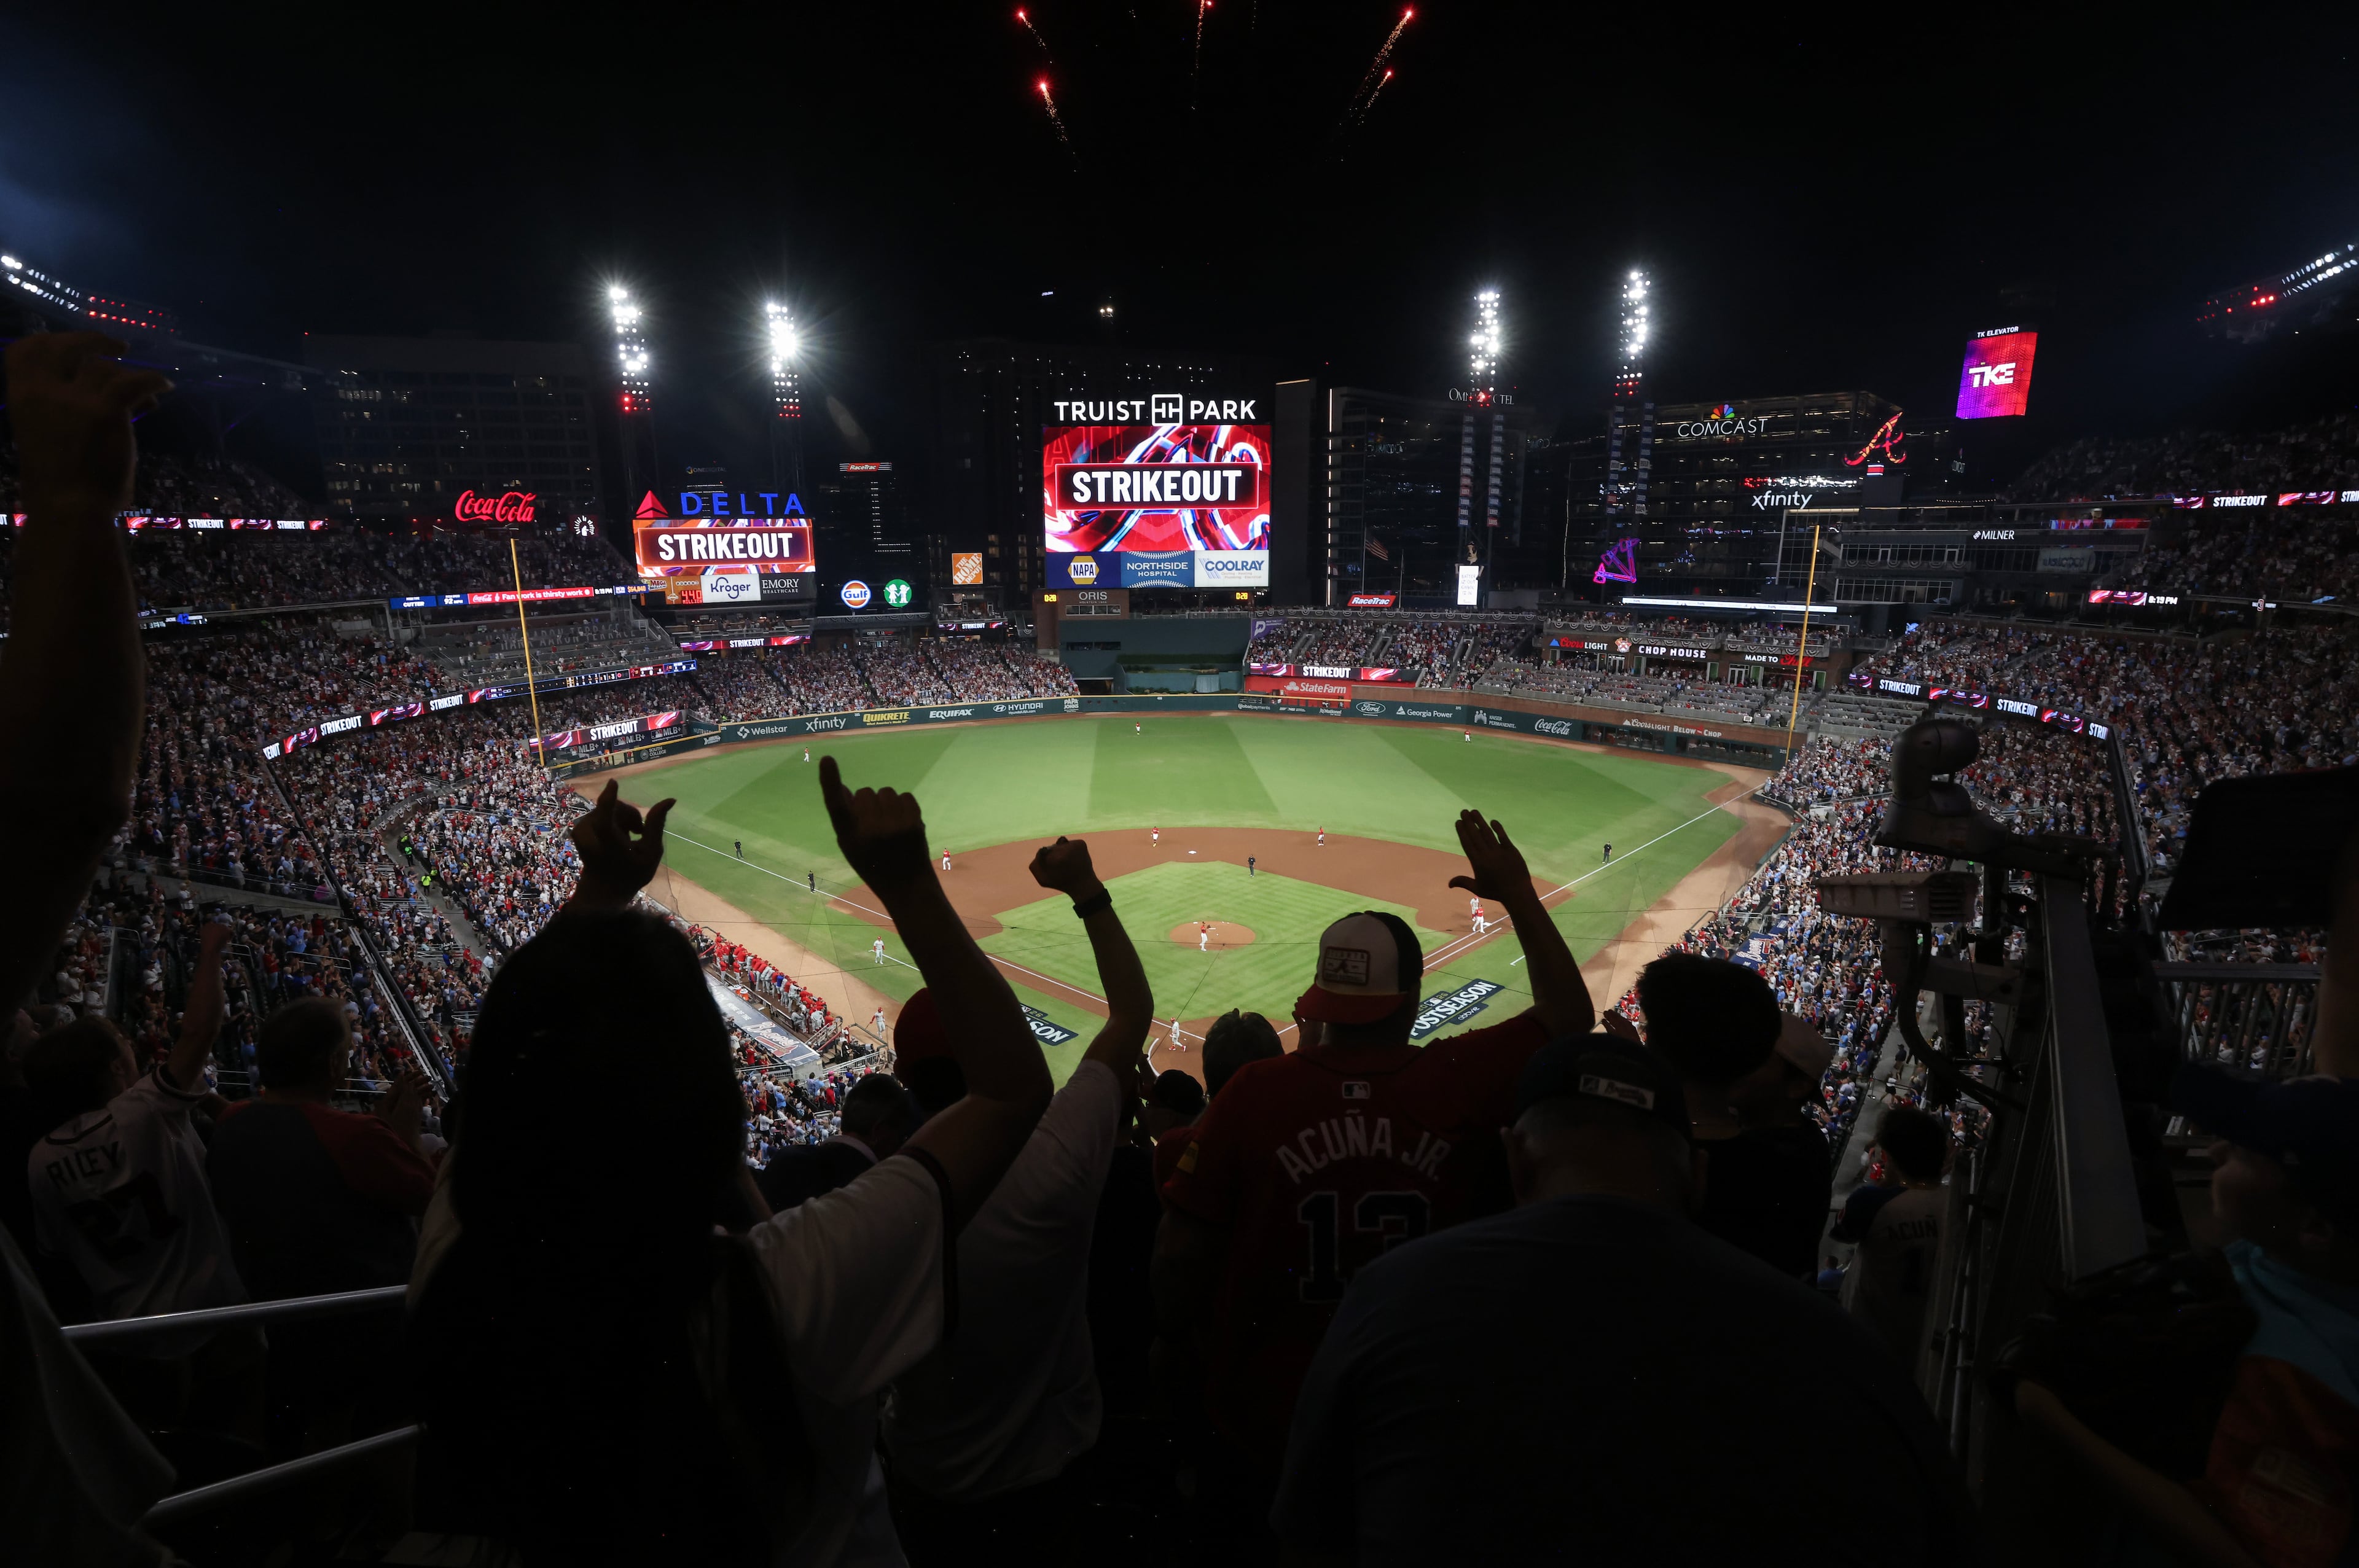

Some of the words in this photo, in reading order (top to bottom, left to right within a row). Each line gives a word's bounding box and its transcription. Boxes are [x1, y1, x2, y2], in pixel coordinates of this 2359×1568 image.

[1987, 326, 2019, 337] ELEVATOR
[1969, 362, 2016, 388] TKE
[1449, 388, 1473, 402] OMN
[1054, 400, 1146, 421] TRUIST
[1190, 400, 1256, 420] PARK
[1678, 418, 1768, 438] COMCAST
[1072, 469, 1242, 502] STRIKEOUT
[455, 490, 537, 522] Coca-Cola
[681, 492, 805, 515] DELTA
[1751, 490, 1812, 510] xfinity
[2213, 495, 2267, 507] STRIKEOUT
[187, 518, 224, 529] STRIKEOUT
[276, 520, 305, 529] STRIKEOUT
[1981, 530, 2015, 541] MILNER
[657, 532, 792, 561] STRIKEOUT
[953, 553, 982, 584] HOME
[955, 556, 968, 569] THE
[1127, 561, 1188, 570] NORTHSIDE
[1205, 560, 1265, 571] COOLRAY
[964, 566, 983, 584] DEPOT
[1073, 564, 1095, 577] NAPA
[711, 577, 751, 599] Kroger
[762, 579, 799, 588] EMORY
[543, 590, 565, 599] thirsty
[681, 590, 702, 599] 440
[843, 590, 867, 599] Gulf
[1079, 591, 1108, 601] ORIS
[2148, 596, 2165, 604] 8:19
[2165, 596, 2178, 605] PM
[1352, 597, 1390, 606] RaceTrac
[177, 613, 190, 625] 42
[730, 638, 764, 648] STRIKEOUT
[1559, 636, 1584, 649] Coors
[1584, 641, 1608, 650] LIGHT
[1638, 646, 1667, 655] CHOP
[1670, 648, 1707, 659] HOUSE
[1303, 666, 1351, 679] STRIKEOUT
[1879, 678, 1922, 696] STRIKEOUT
[430, 694, 463, 711] STRIKEOUT
[1360, 704, 1380, 712] Ford
[1997, 698, 2039, 717] STRIKEOUT
[863, 711, 910, 722] QUIKRETE
[929, 709, 972, 719] EQUIFAX
[1407, 709, 1432, 719] Georgia
[321, 715, 362, 736] STRIKEOUT
[590, 720, 638, 741] STRIKEOUT
[751, 725, 788, 736] Wellstar
[805, 716, 847, 732] xfinity
[1535, 718, 1573, 736] Coca-Cola
[1631, 719, 1652, 729] Coors
[663, 727, 682, 737] MLB+
[626, 734, 645, 744] MLB+
[578, 743, 599, 754] MLB+
[1410, 981, 1498, 1037] POSTSEASON
[1276, 1108, 1393, 1184] ACUÑA
[1401, 1131, 1452, 1182] JR.
[45, 1141, 120, 1193] RILEY
